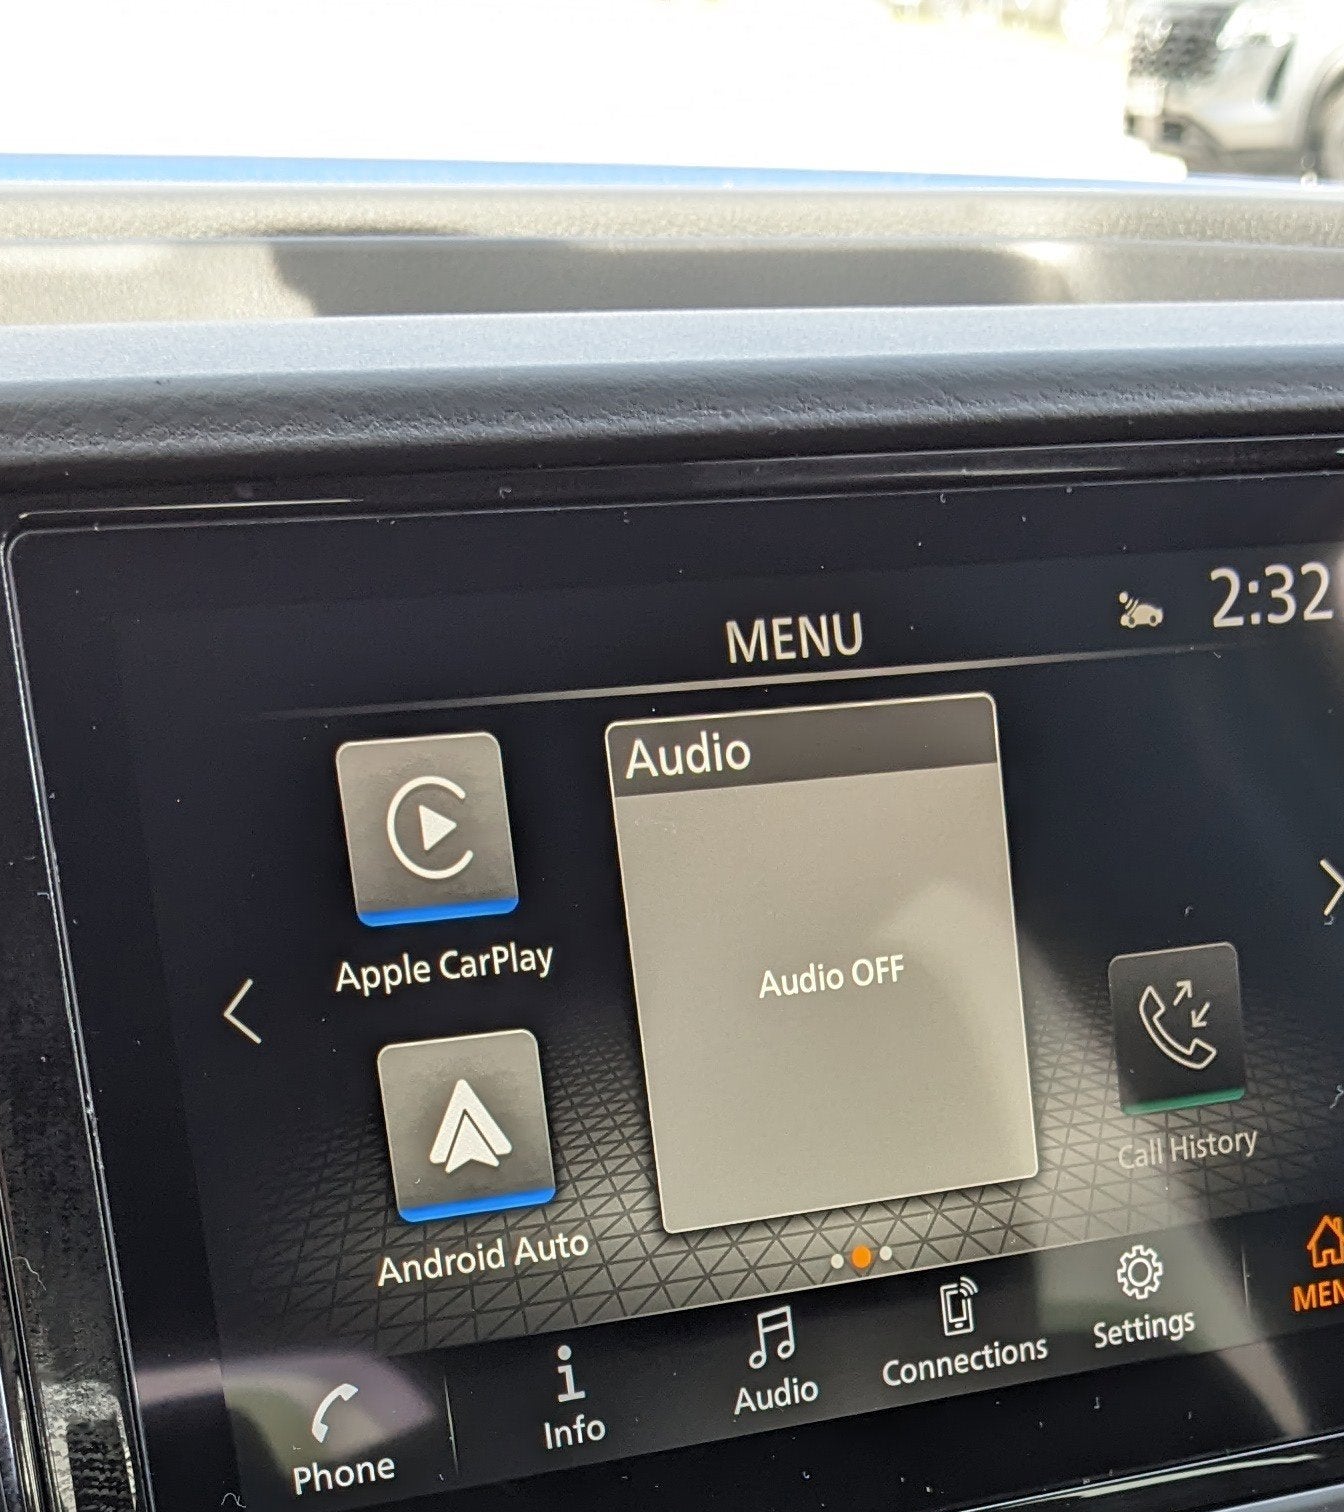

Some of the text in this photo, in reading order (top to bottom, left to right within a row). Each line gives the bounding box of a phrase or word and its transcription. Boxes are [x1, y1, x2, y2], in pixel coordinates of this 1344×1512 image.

[1208, 558, 1336, 630] 2:32
[724, 610, 864, 666] MENU
[624, 728, 753, 780] Audio
[334, 940, 555, 998] Apple CarPlay
[758, 954, 906, 1000] Audio OFF
[1117, 1126, 1259, 1172] Call History
[376, 1230, 590, 1288] Android Auto
[1092, 1308, 1196, 1350] Settings
[881, 1336, 1050, 1388] Connections
[732, 1378, 820, 1416] Audio
[544, 1414, 607, 1450] Info
[292, 1456, 397, 1496] Phone
